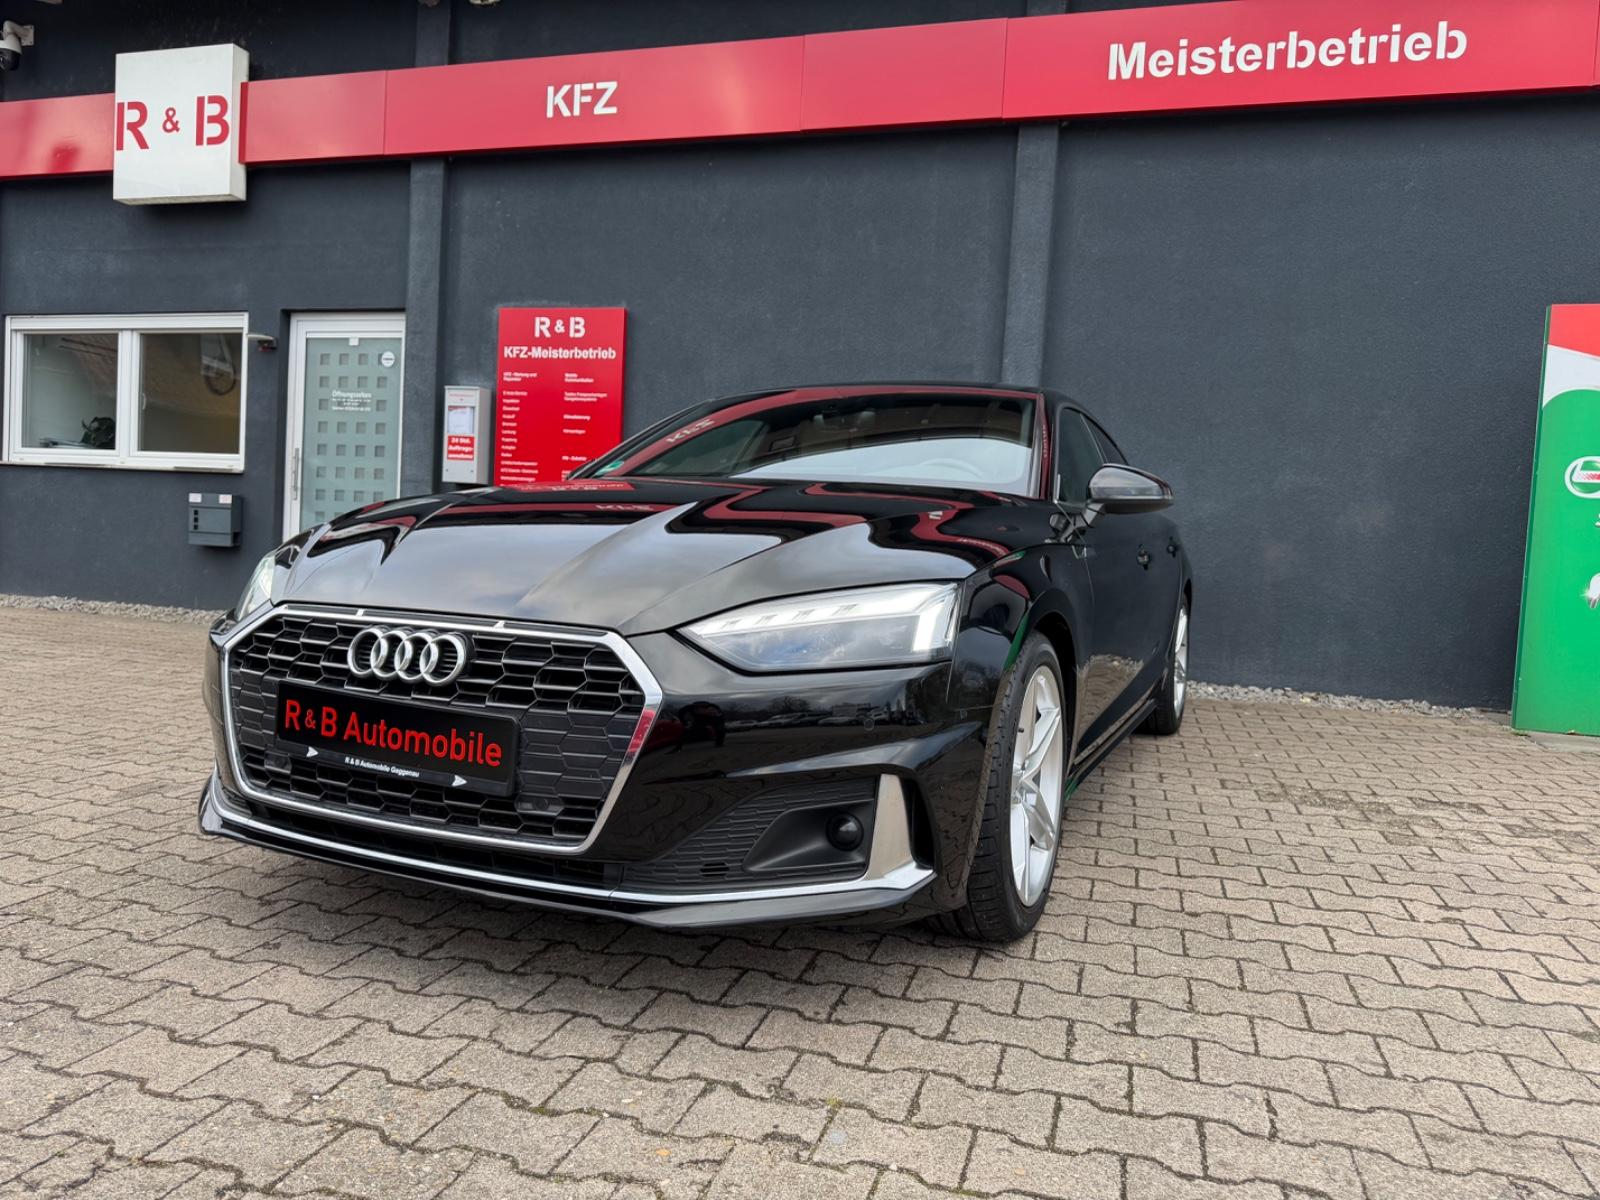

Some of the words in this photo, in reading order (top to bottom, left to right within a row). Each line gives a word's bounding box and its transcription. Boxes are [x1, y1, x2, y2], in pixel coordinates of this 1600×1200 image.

[1107, 21, 1468, 81] Meisterbetrieb
[546, 80, 618, 119] KFZ
[116, 101, 150, 151] R
[162, 107, 180, 133] &
[195, 95, 230, 146] B
[534, 317, 551, 338] R
[554, 320, 565, 334] &
[569, 317, 585, 338] B
[503, 345, 617, 360] KFZ-Meisterbetrieb
[285, 699, 300, 731] R
[304, 708, 316, 730] &
[320, 706, 338, 738] B
[344, 712, 502, 767] Automobile
[360, 760, 390, 772] Automobile
